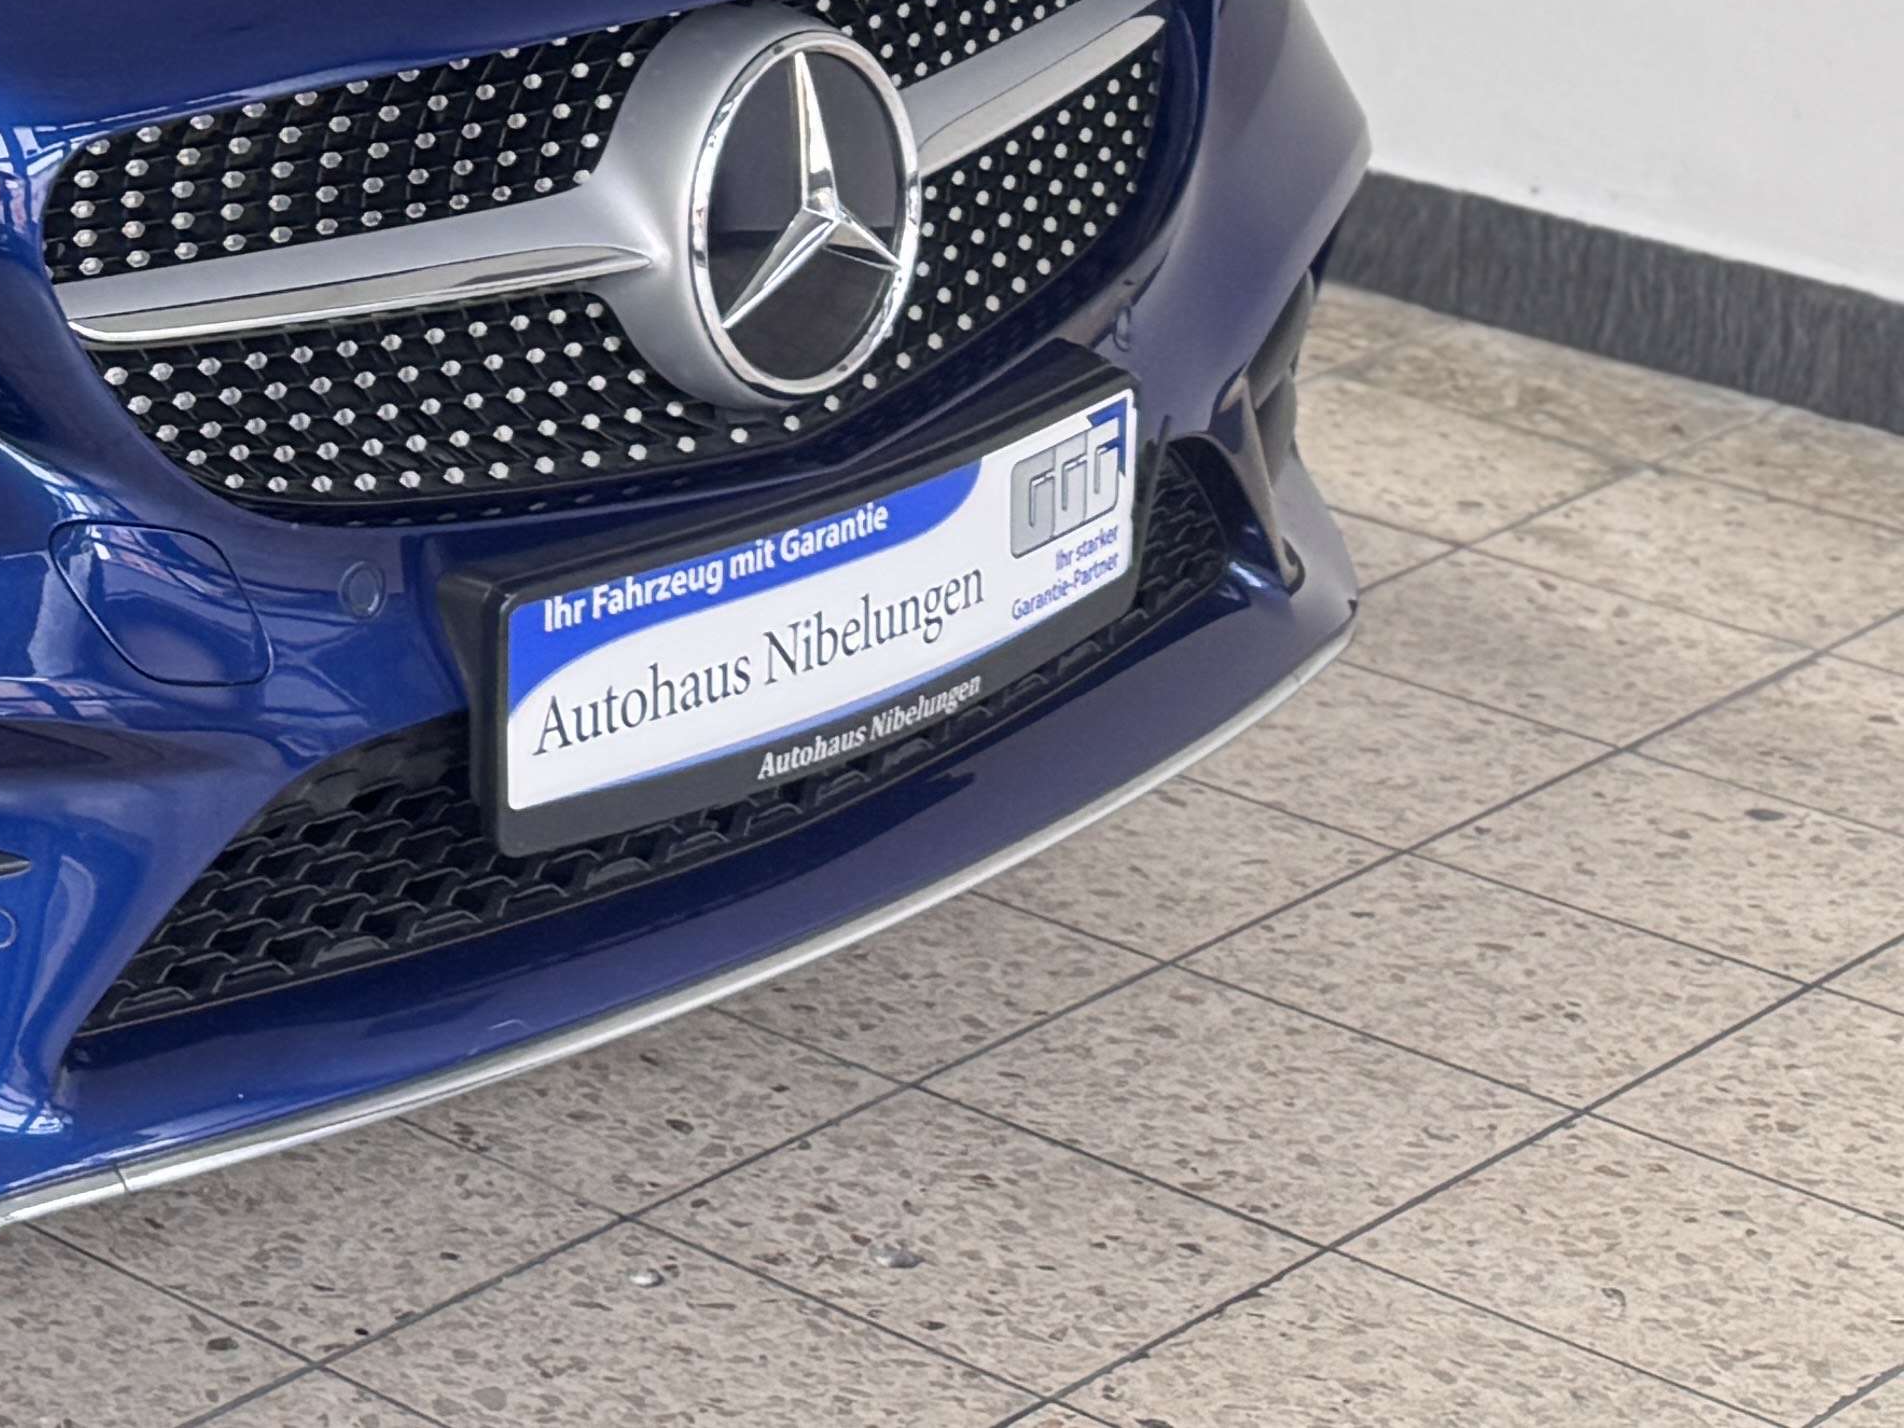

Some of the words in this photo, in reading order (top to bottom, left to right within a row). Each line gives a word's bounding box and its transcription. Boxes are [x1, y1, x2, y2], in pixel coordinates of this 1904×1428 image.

[544, 595, 587, 633] Ihr
[592, 559, 725, 620] Fahrzeug
[729, 538, 775, 581] mit
[780, 501, 889, 564] Garantie
[1011, 552, 1119, 620] Garantie-Partner
[1055, 548, 1075, 571] Ihr
[1076, 525, 1119, 561] starker
[531, 654, 752, 757] Autohaus
[762, 568, 985, 686] Nibelungen
[756, 724, 868, 781] Autohaus
[869, 674, 982, 743] Nibelungen
